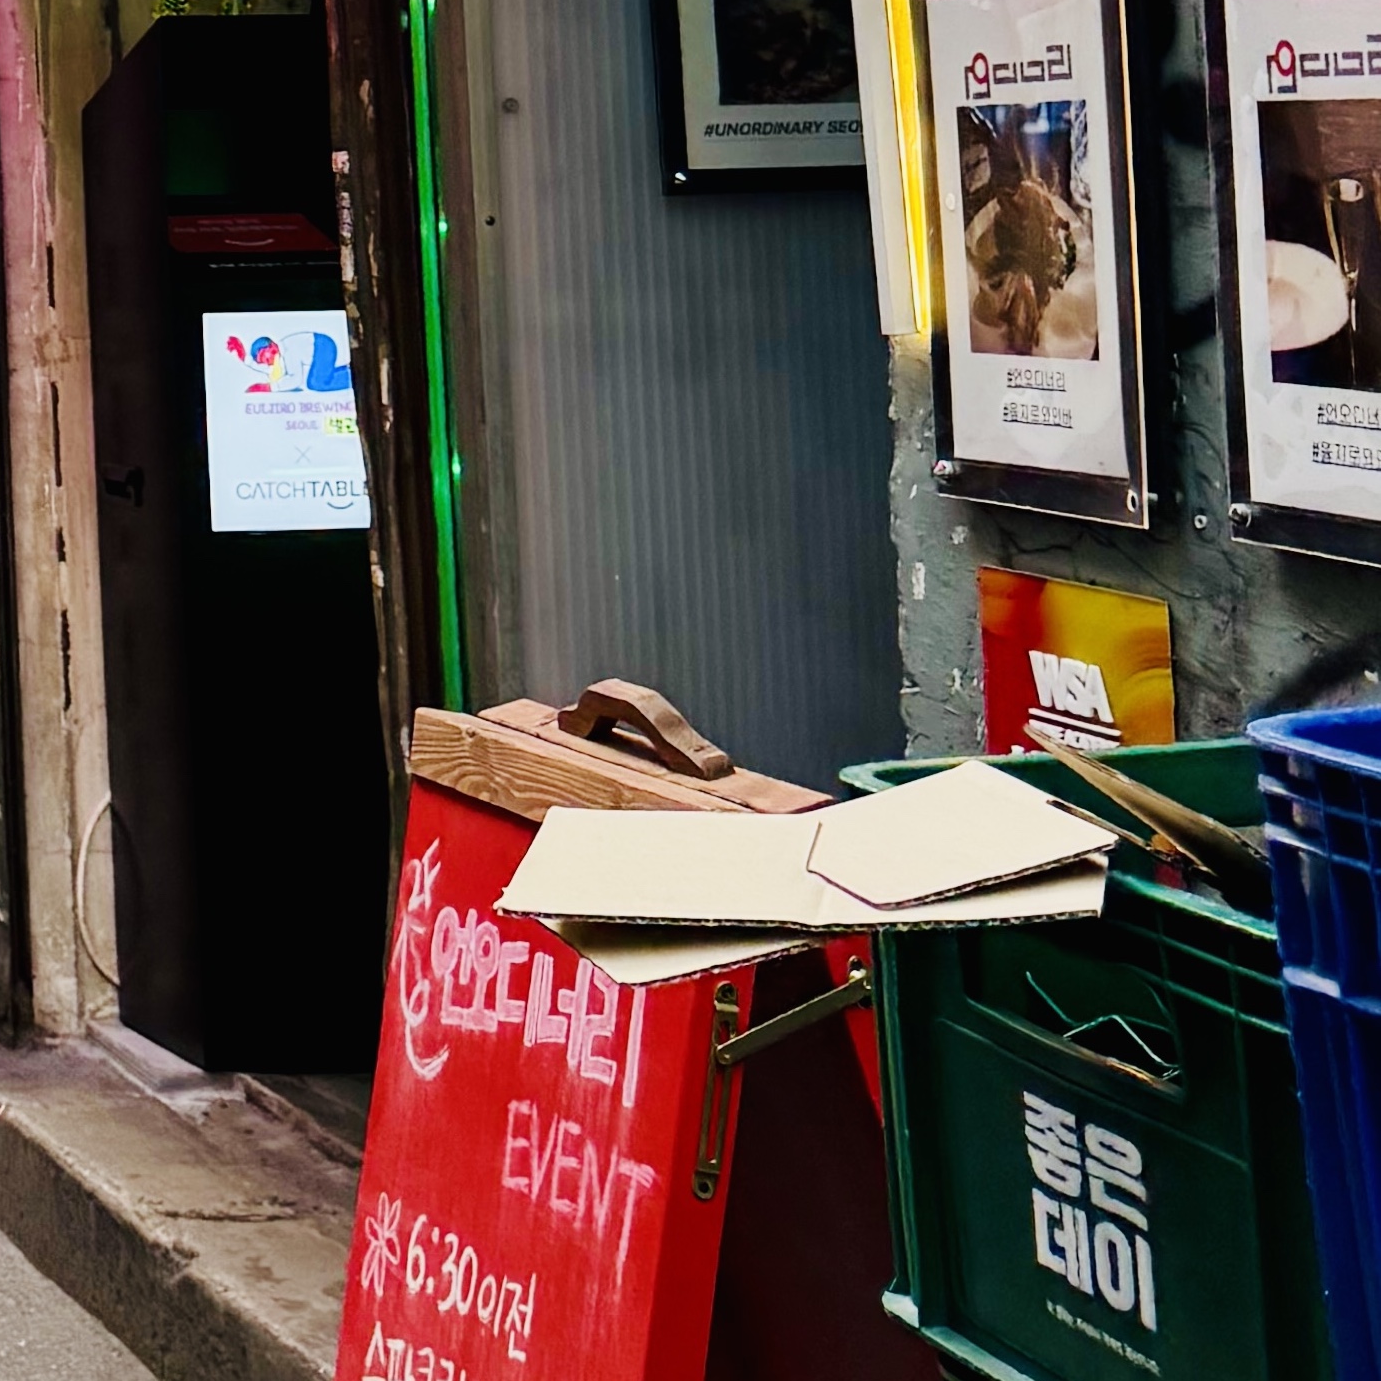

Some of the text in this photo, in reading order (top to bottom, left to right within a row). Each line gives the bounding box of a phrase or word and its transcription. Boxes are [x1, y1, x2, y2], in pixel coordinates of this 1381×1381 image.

[704, 119, 865, 139] #UNORDINARY SEO
[407, 837, 441, 912] 2F
[501, 1098, 660, 1289] EVENT
[1023, 1089, 1148, 1232] 좋은
[405, 1212, 537, 1363] 6:30이전
[1031, 1187, 1158, 1333] 데이
